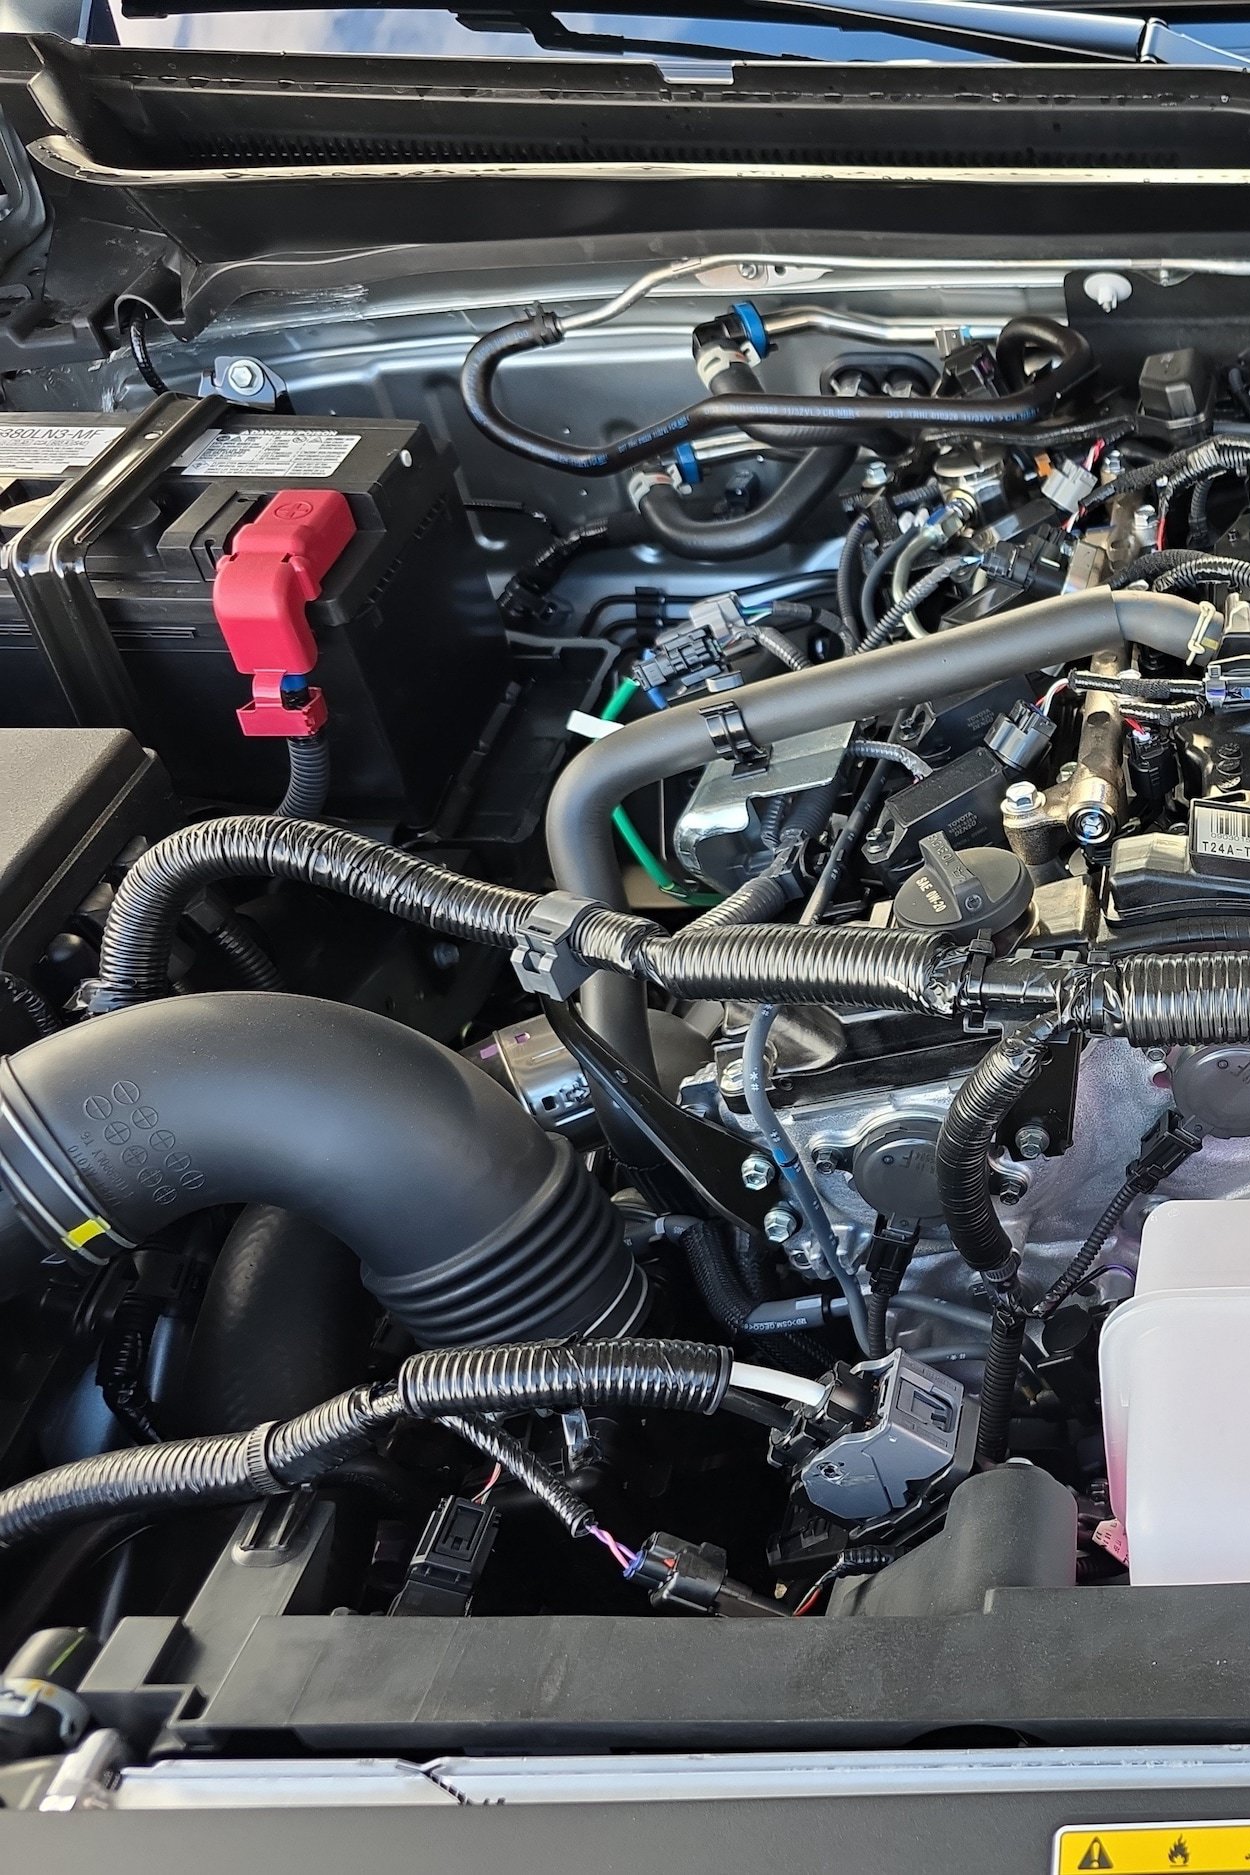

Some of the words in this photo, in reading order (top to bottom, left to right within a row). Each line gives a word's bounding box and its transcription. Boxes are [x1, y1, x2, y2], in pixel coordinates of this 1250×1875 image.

[948, 811, 974, 829] TOYOTA
[954, 820, 977, 838] DENSO
[915, 876, 933, 893] SAE
[925, 890, 947, 914] 0W-20
